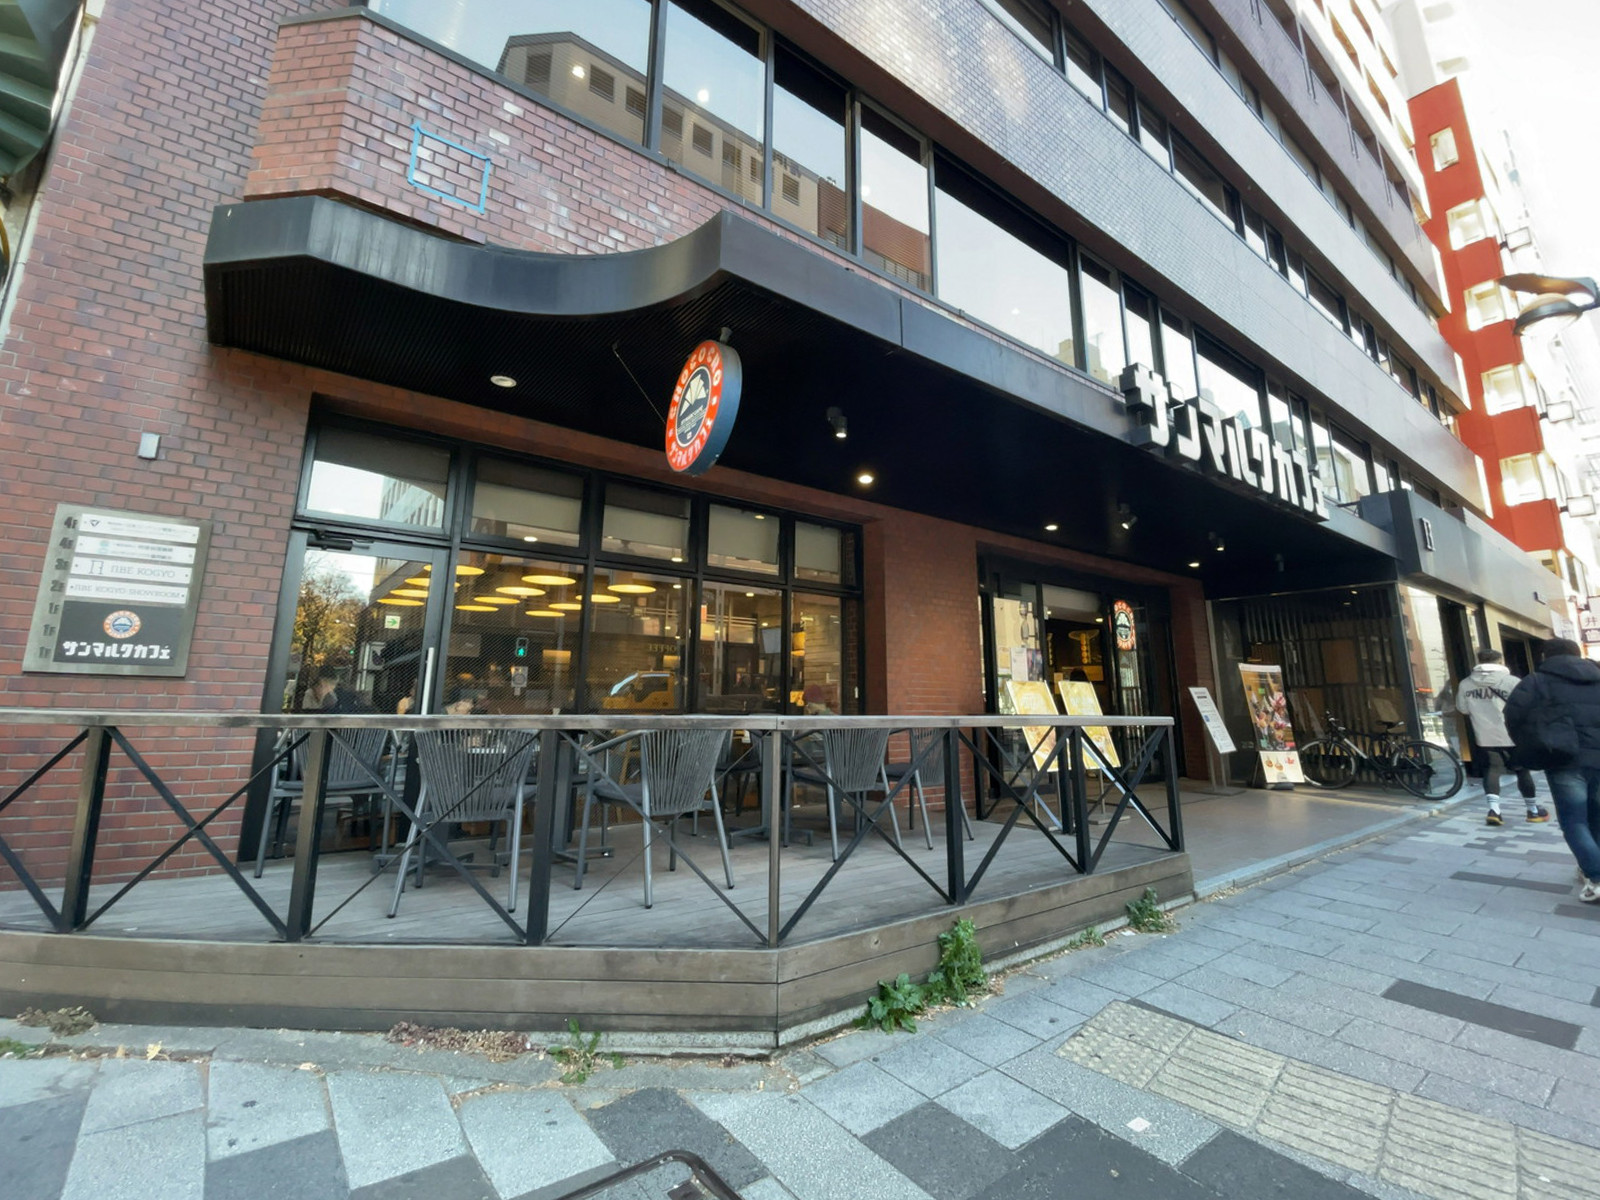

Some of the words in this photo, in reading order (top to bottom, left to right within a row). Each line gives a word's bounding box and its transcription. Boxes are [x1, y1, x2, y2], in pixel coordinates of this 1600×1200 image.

[1127, 362, 1330, 521] サンマルクカフェ
[64, 516, 78, 530] 4F
[50, 580, 66, 593] 2F
[62, 641, 171, 660] サンマルクカフェ
